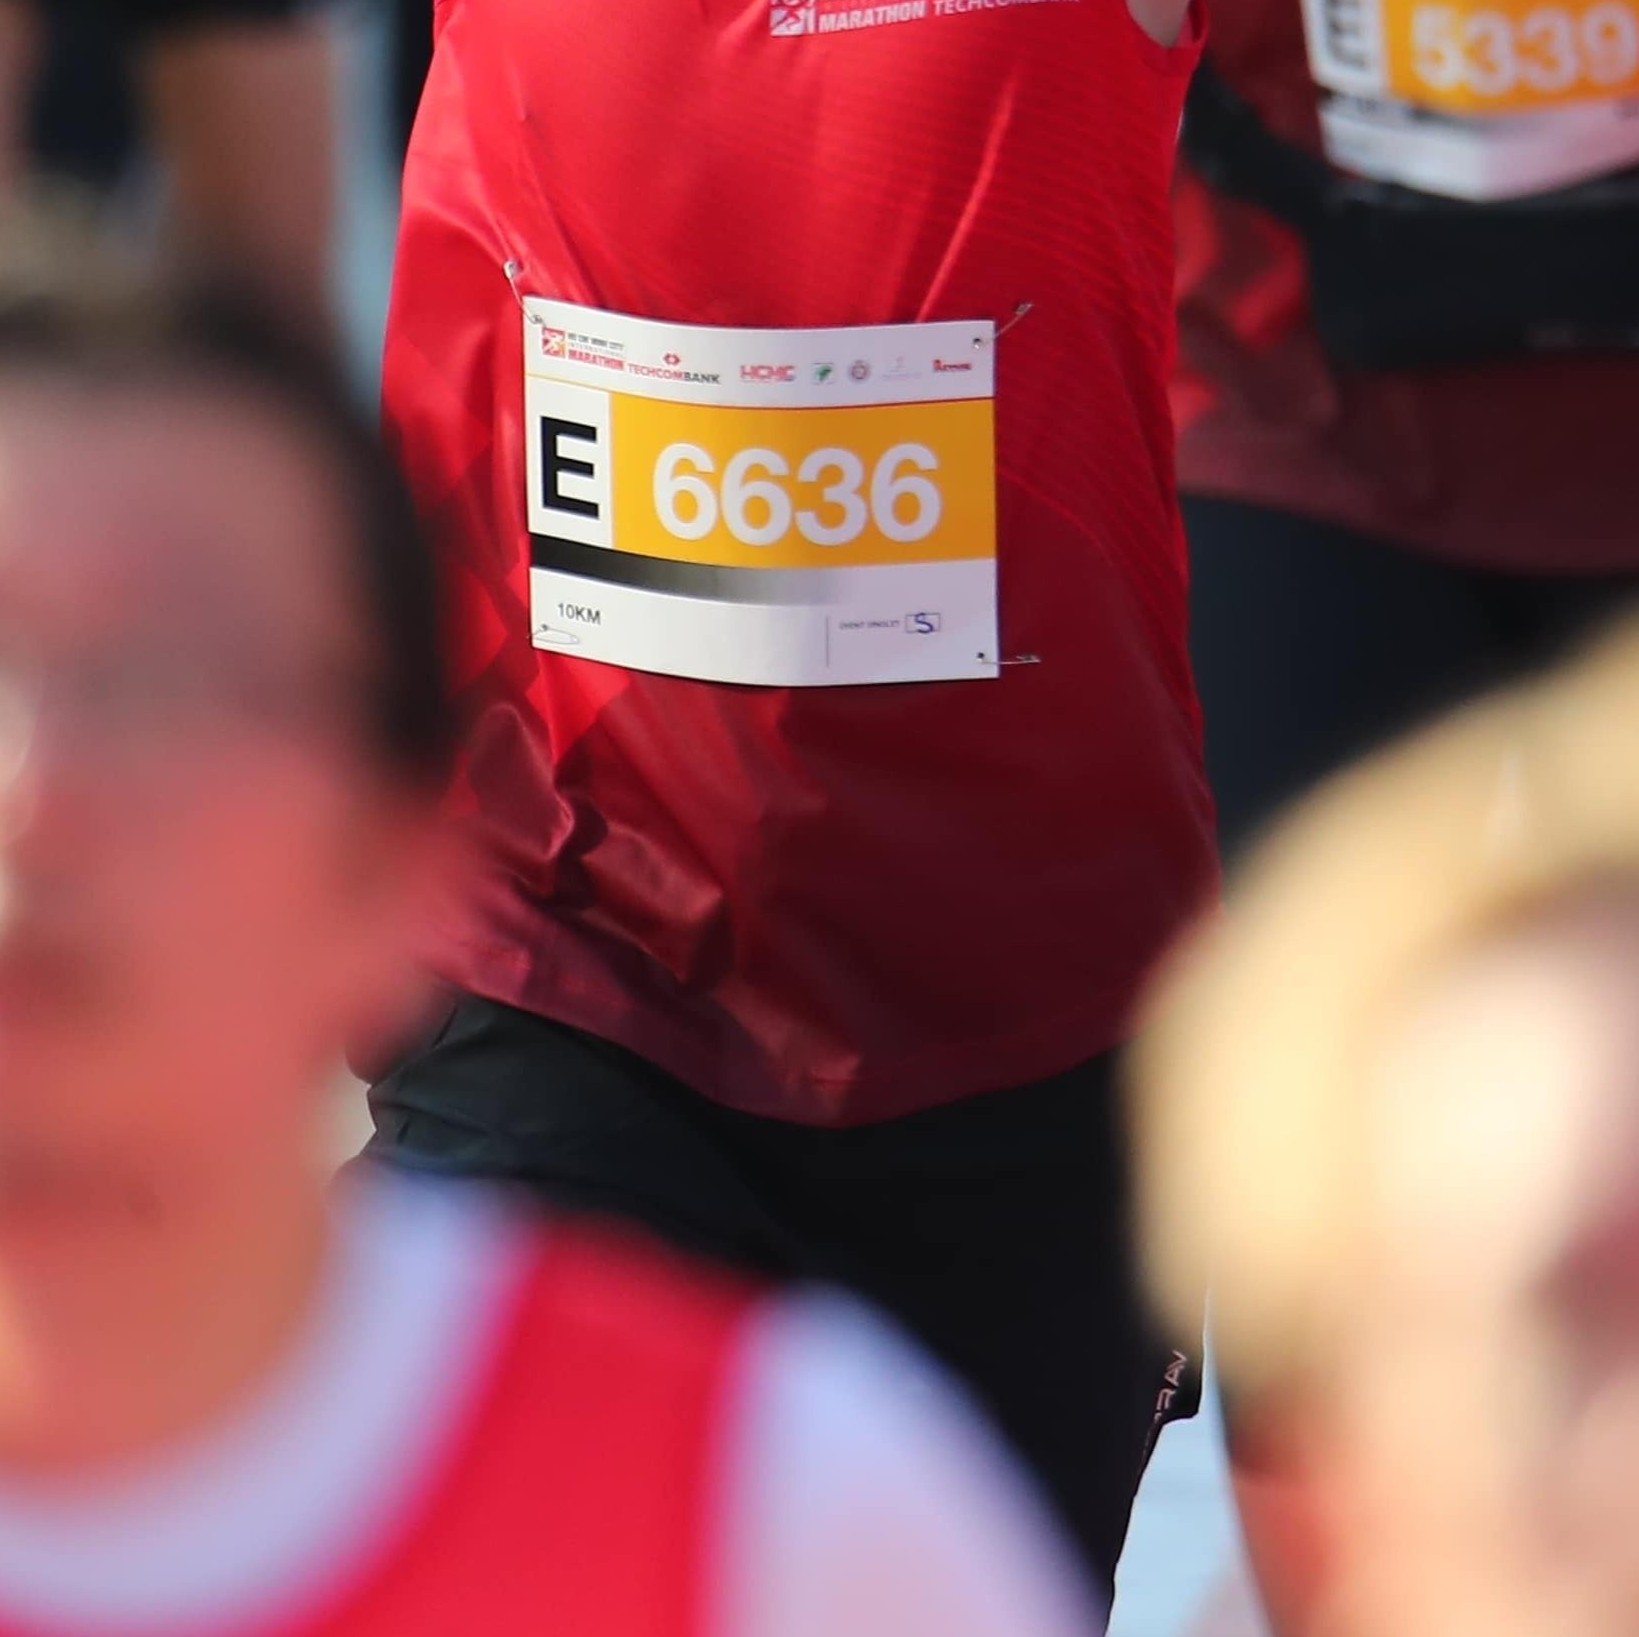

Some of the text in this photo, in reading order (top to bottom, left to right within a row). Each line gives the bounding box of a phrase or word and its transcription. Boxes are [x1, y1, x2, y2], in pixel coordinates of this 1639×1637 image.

[819, 0, 927, 34] MARATHON
[568, 348, 625, 372] MARATHON
[628, 363, 721, 385] TECHCOMBANK
[539, 415, 944, 547] E 6636
[557, 601, 602, 626] 10KM
[914, 611, 935, 634] S
